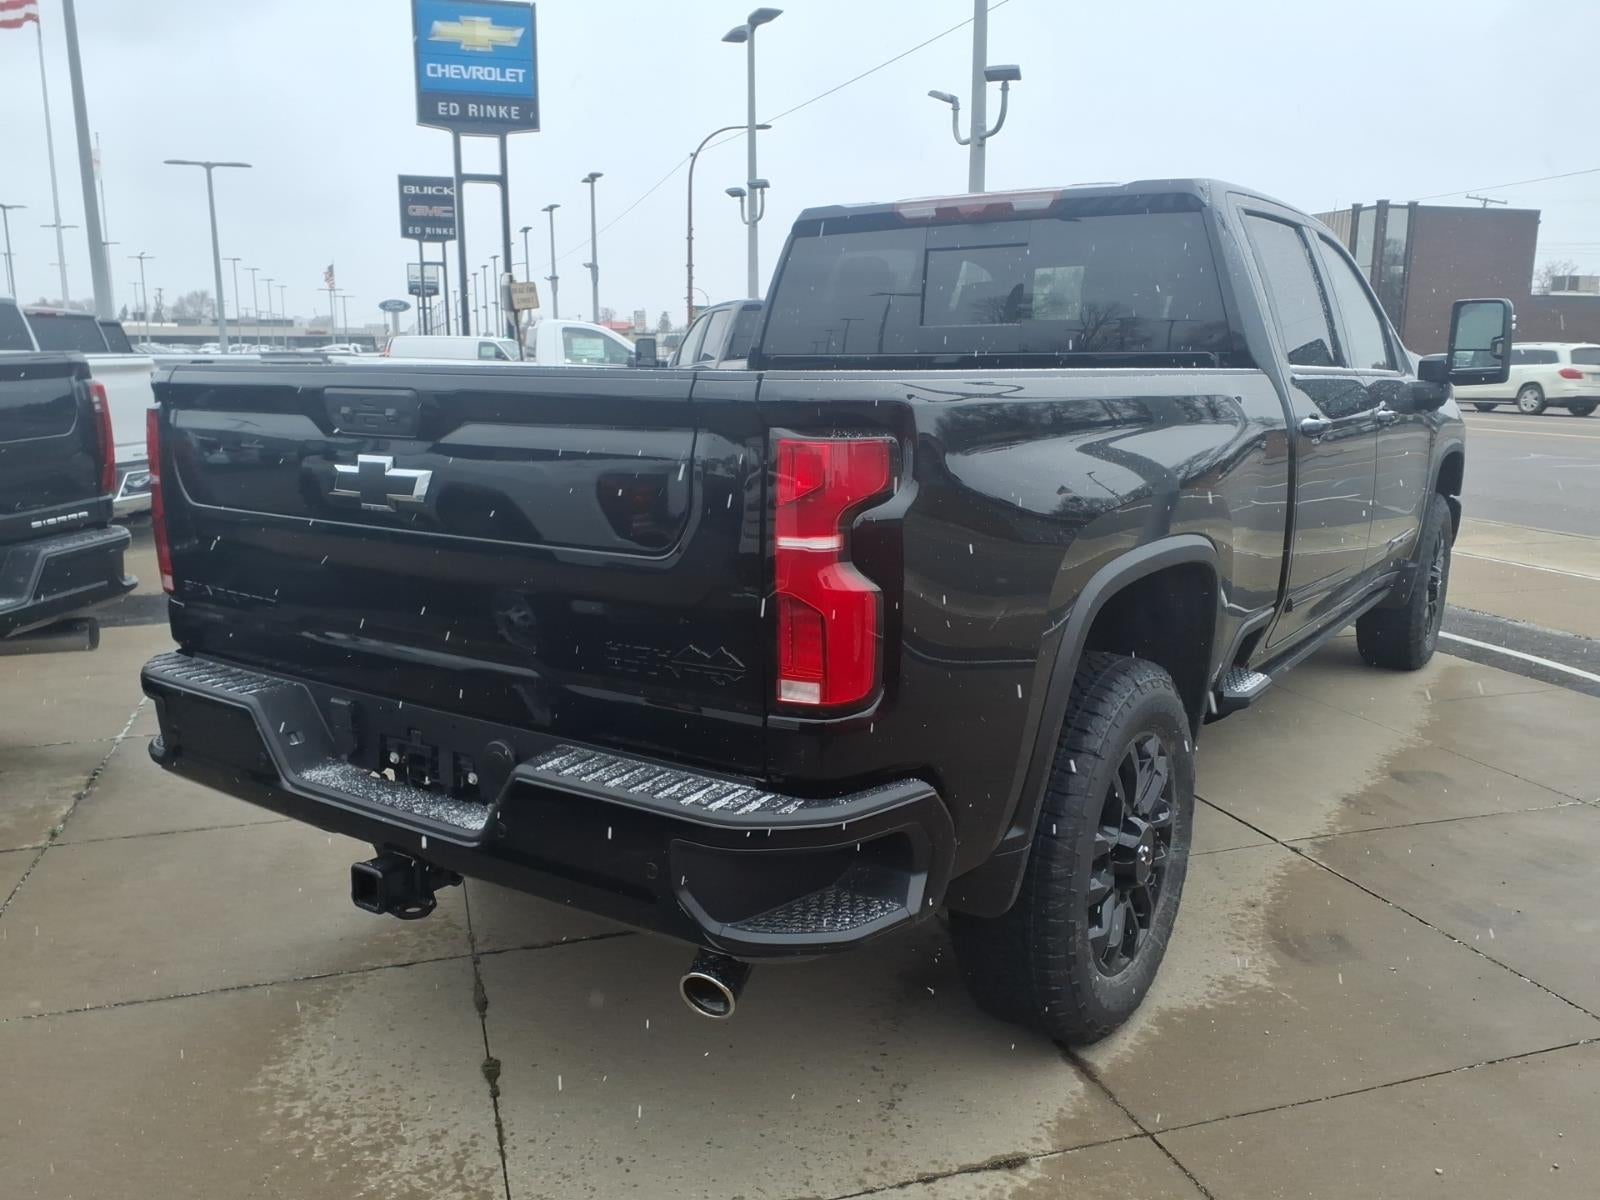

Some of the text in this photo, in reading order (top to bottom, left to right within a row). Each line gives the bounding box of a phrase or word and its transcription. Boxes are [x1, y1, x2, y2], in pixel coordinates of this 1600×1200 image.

[426, 63, 526, 83] CHEVROLET
[437, 102, 521, 119] ED RINKE
[403, 185, 455, 195] BUICK
[408, 205, 454, 217] GMC
[426, 227, 455, 235] RINKE
